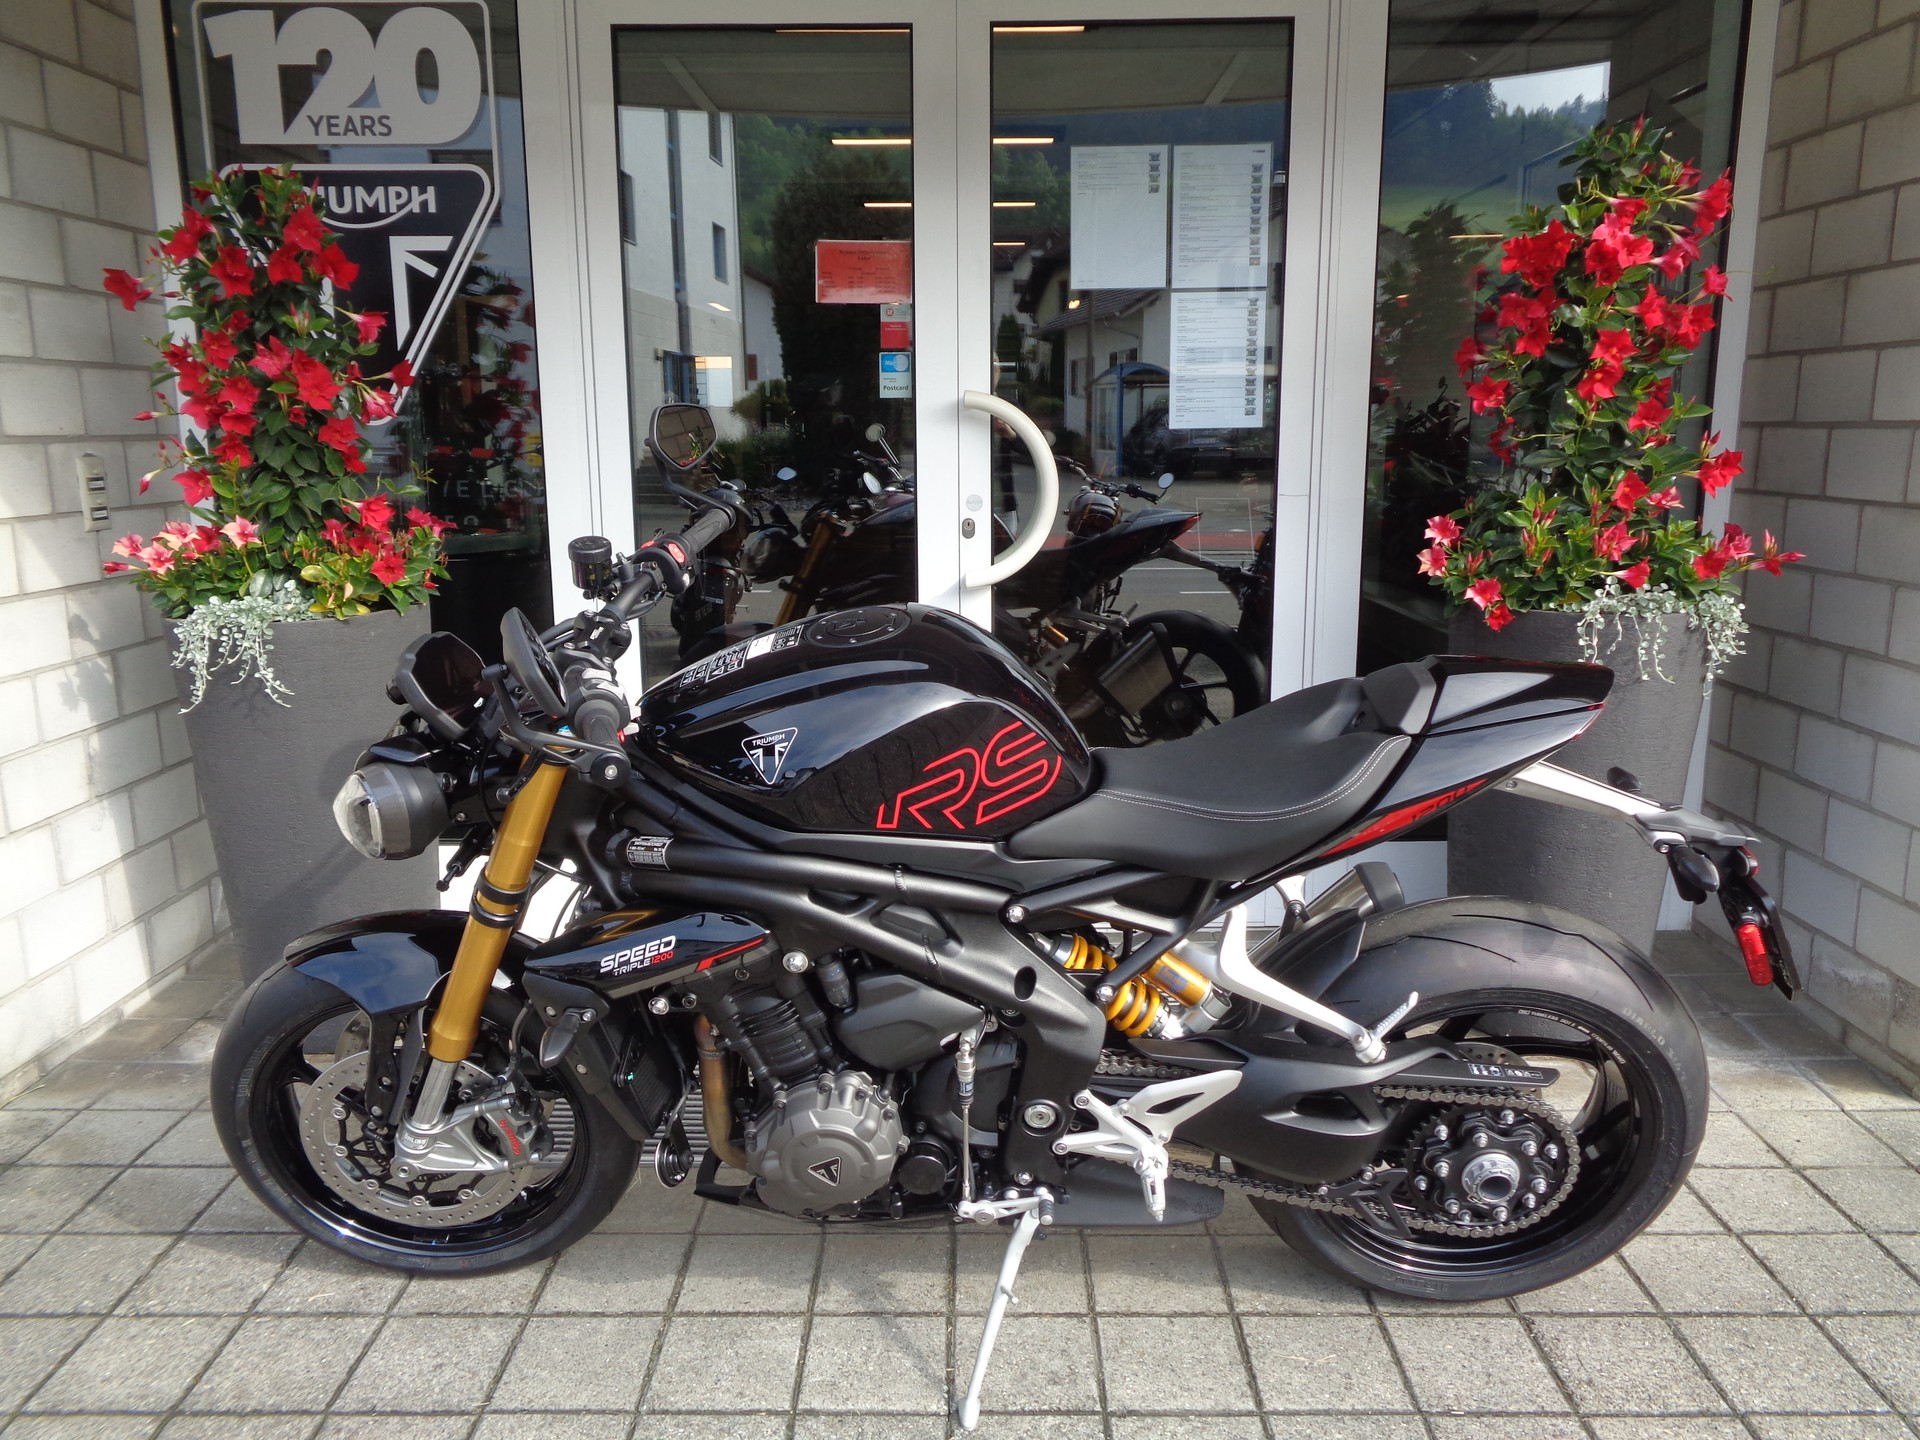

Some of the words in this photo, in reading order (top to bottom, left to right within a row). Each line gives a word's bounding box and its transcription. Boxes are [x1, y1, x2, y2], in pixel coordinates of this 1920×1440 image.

[203, 7, 482, 145] 120
[307, 115, 392, 137] YEARS
[301, 185, 437, 214] IUMPH
[752, 733, 785, 746] TRIUMPH
[876, 720, 1062, 829] RS
[600, 935, 676, 973] SPEED
[613, 958, 651, 976] TRIPLE
